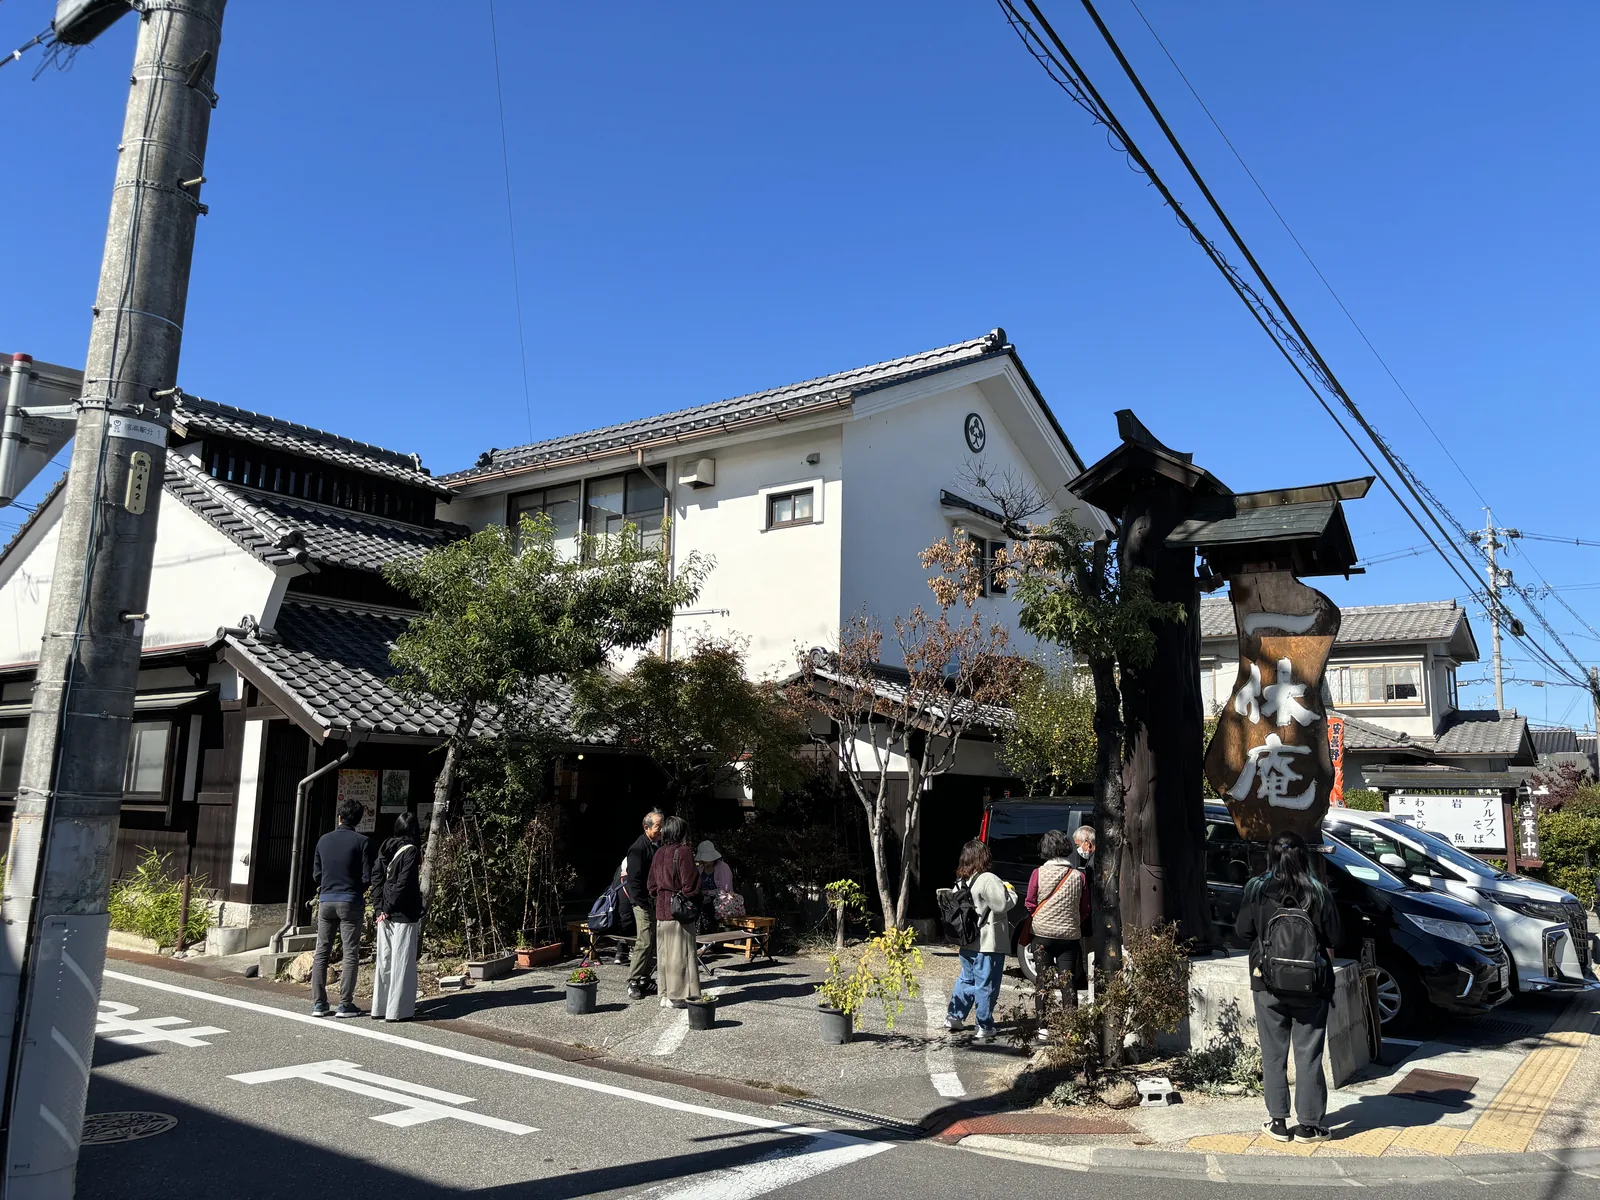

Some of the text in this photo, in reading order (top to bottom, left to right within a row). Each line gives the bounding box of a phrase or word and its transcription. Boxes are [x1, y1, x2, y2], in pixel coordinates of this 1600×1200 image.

[1227, 609, 1321, 811] 一休庵
[1415, 798, 1426, 830] わさび
[1473, 819, 1484, 844] そば
[1483, 798, 1496, 837] アルプス
[1521, 801, 1537, 857] 営業中
